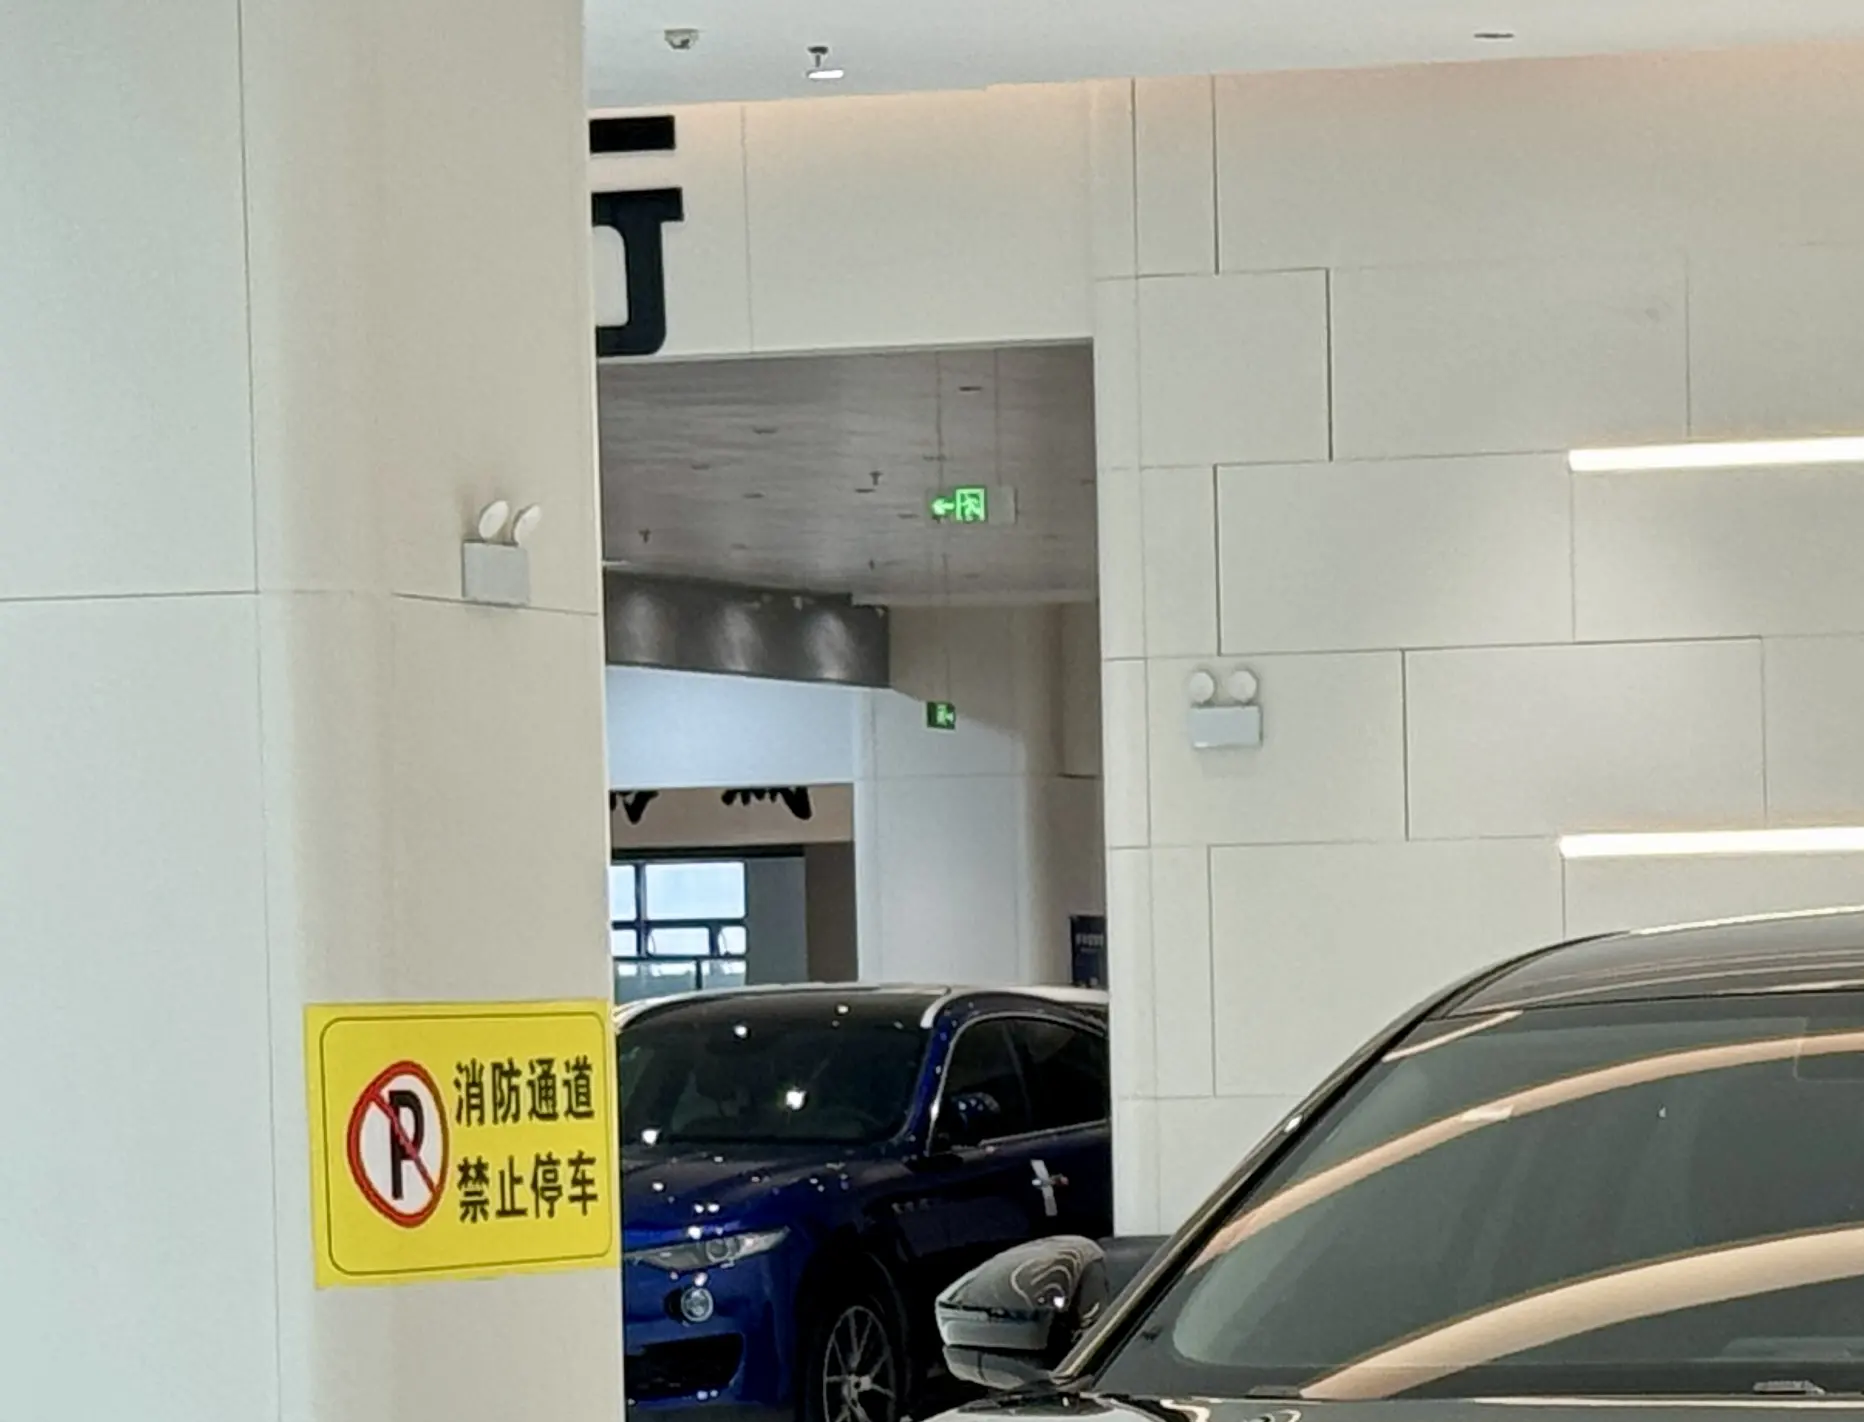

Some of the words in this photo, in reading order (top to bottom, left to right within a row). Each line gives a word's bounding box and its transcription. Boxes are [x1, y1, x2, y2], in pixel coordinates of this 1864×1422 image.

[453, 1054, 596, 1128] 消防通道
[456, 1149, 599, 1224] 禁止停车
